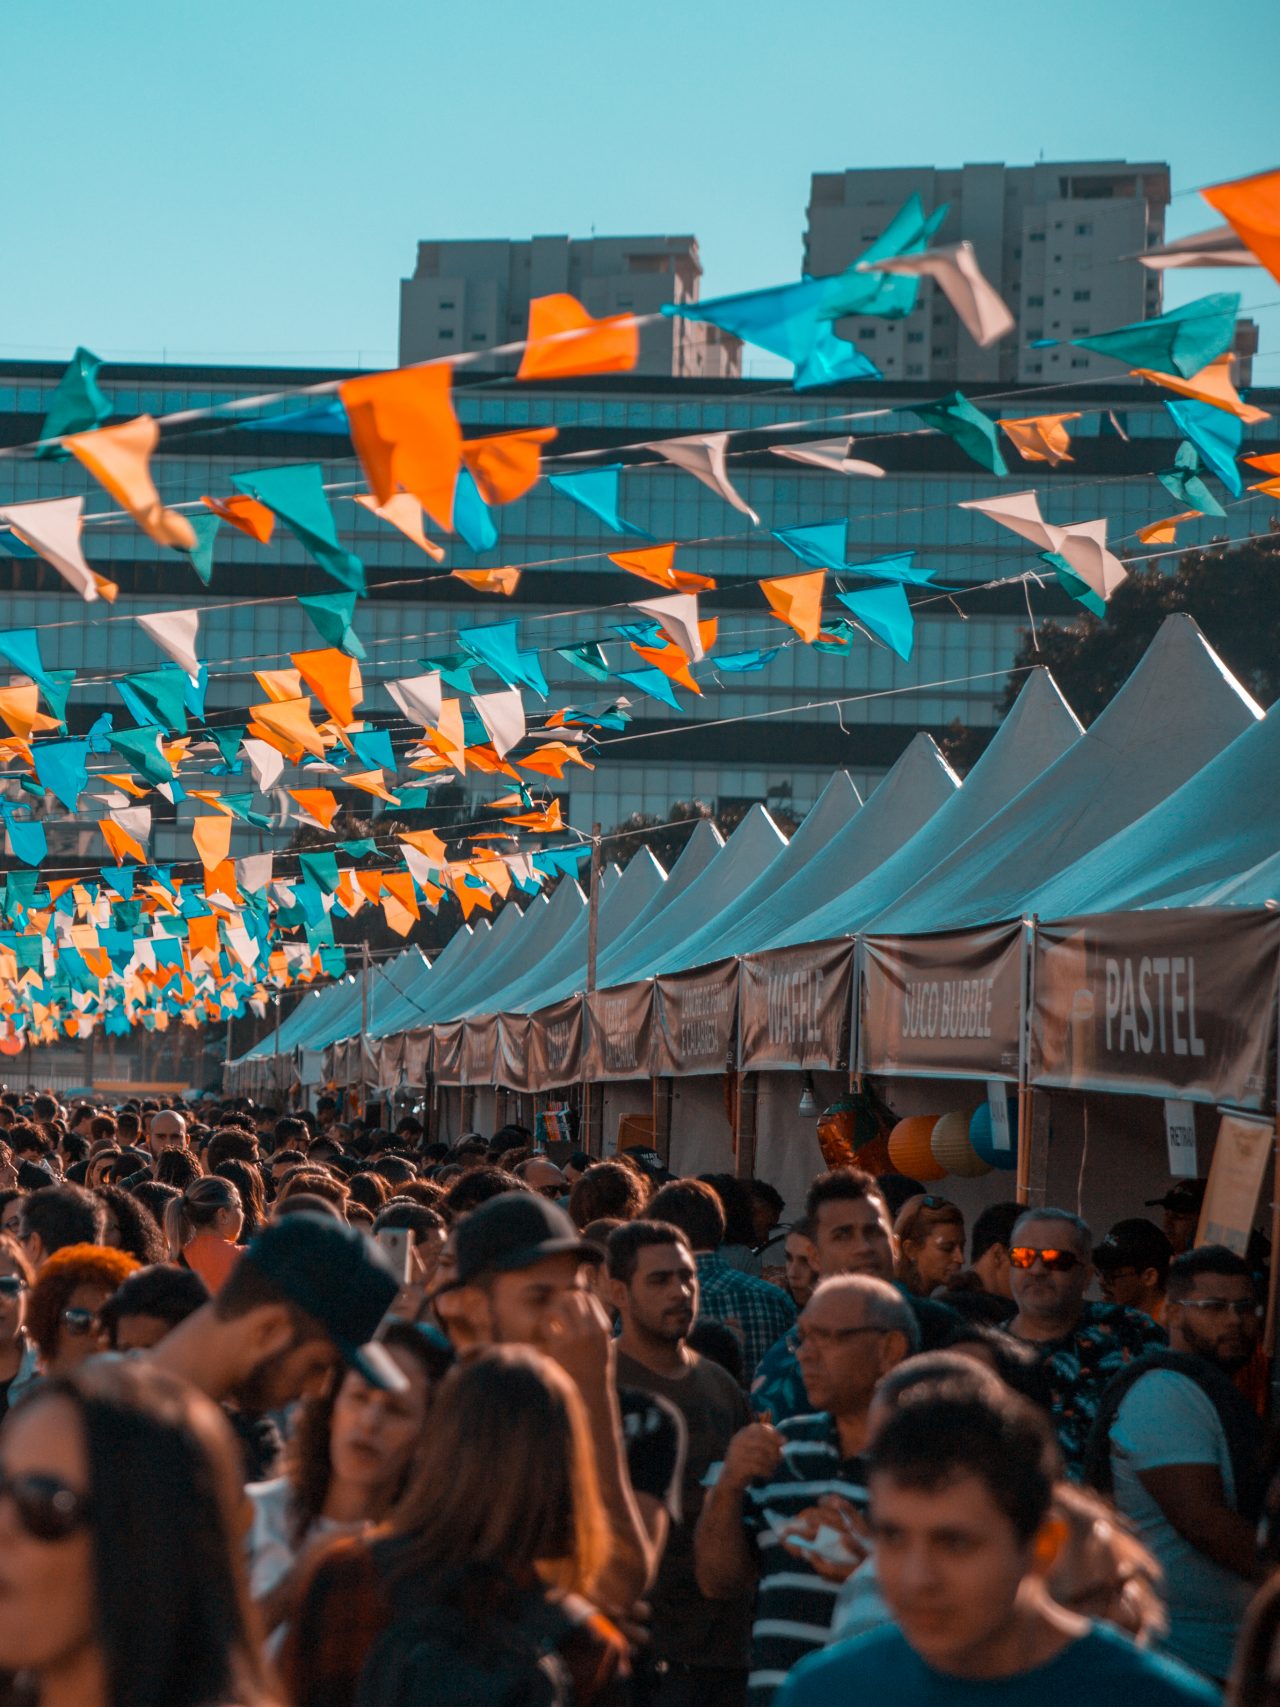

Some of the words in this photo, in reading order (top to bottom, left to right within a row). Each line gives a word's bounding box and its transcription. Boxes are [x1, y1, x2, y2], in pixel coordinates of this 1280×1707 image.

[768, 969, 824, 1044] WAFFLE
[902, 981, 939, 1038] SUCO
[940, 978, 994, 1039] BUBBLE
[1105, 956, 1205, 1056] PASTEL
